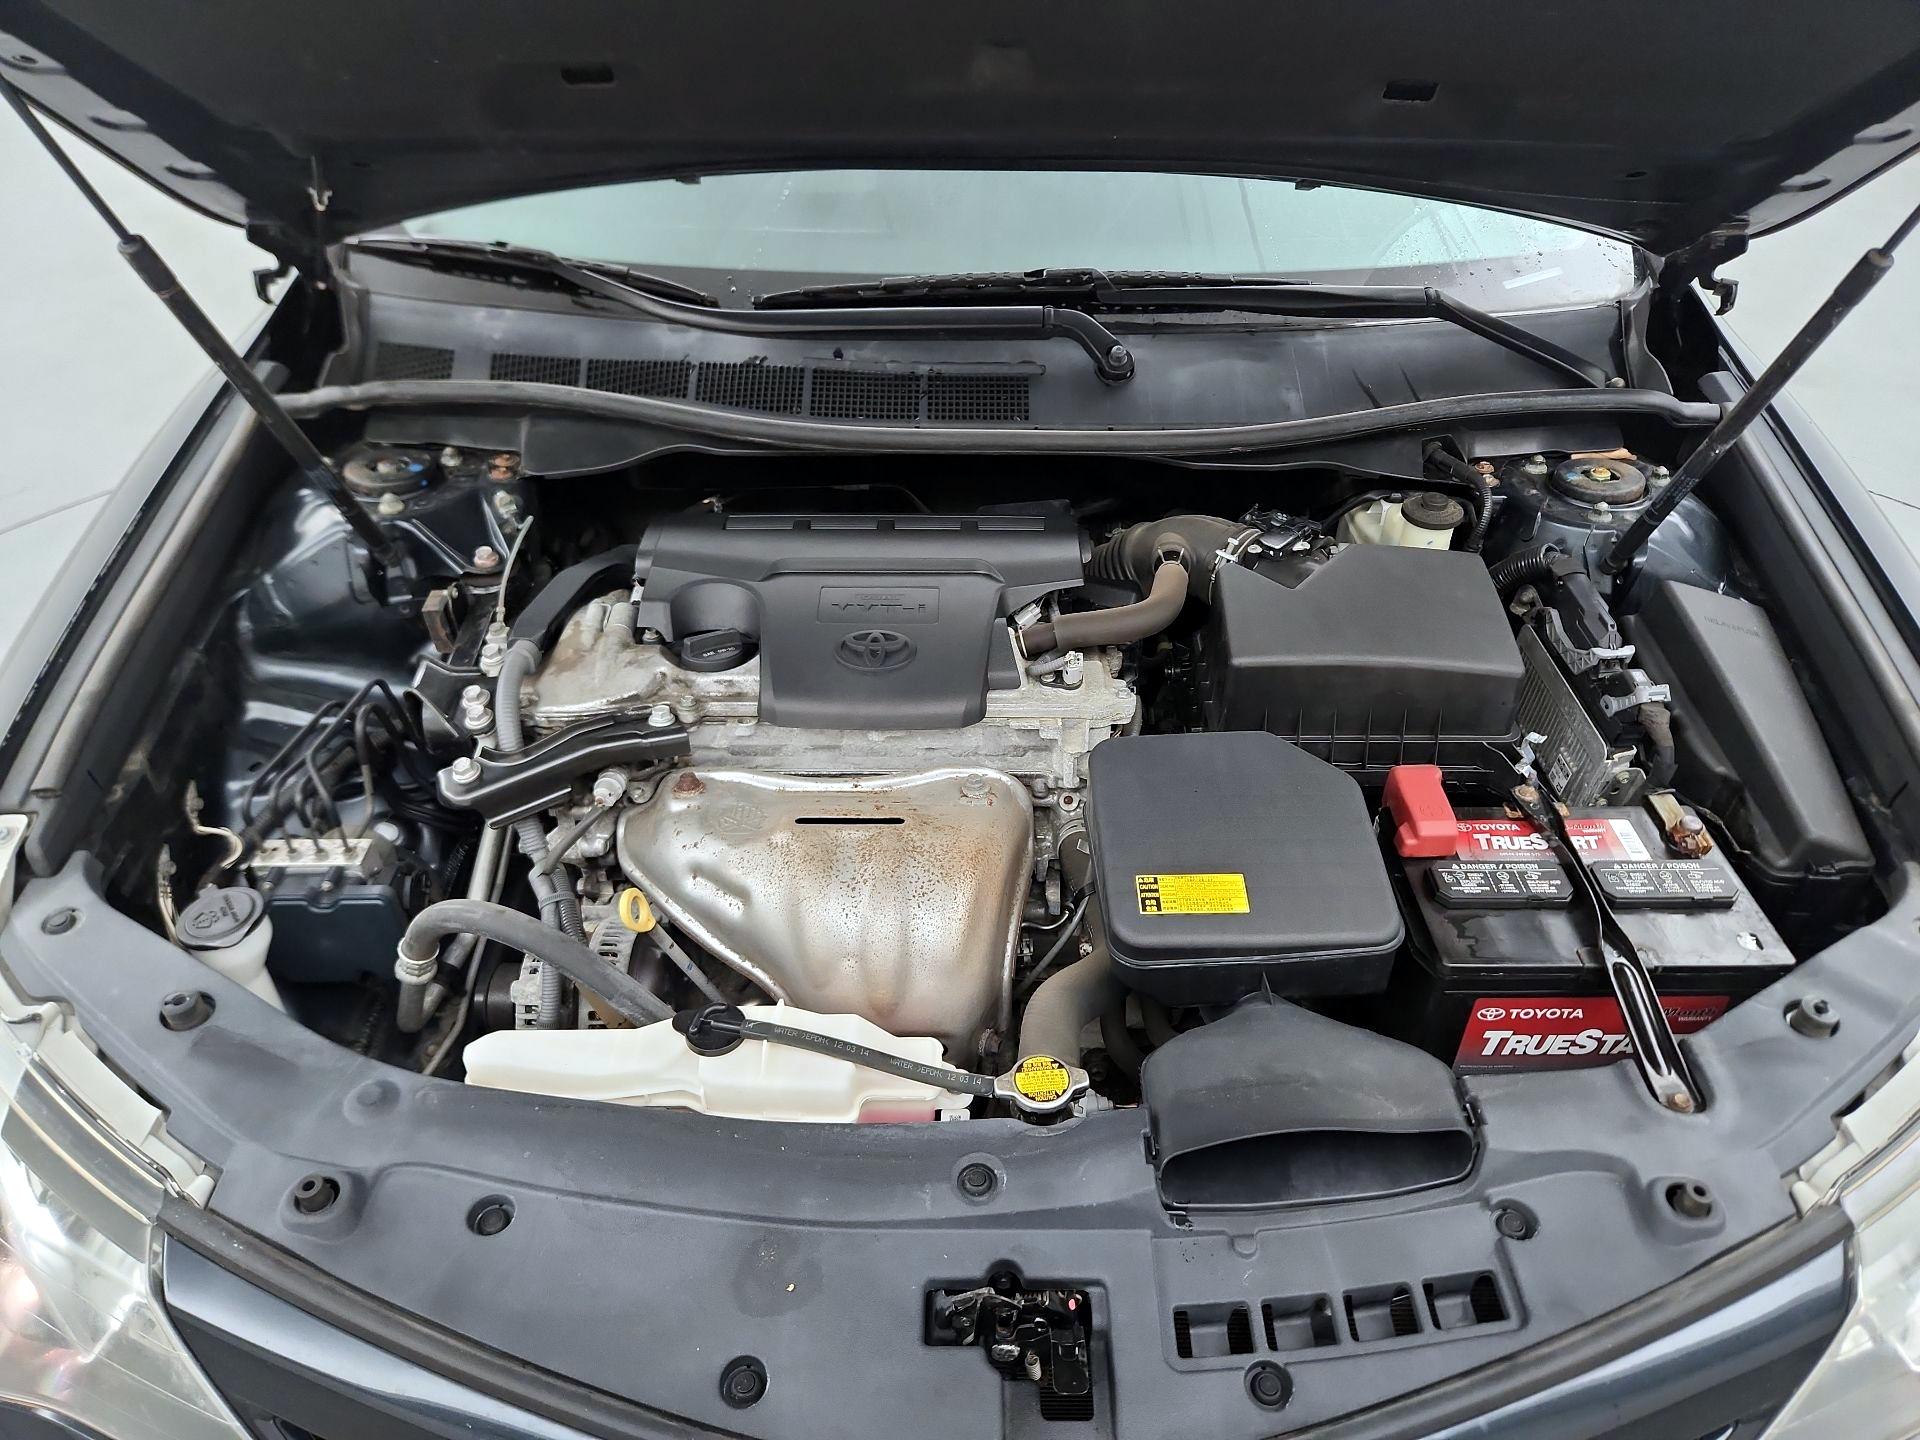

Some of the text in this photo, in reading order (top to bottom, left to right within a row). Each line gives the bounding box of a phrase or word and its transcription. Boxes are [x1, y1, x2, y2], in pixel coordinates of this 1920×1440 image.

[1473, 823, 1520, 831] TOYOTA
[1473, 832, 1599, 850] TRUESRT
[1510, 1008, 1584, 1019] TOYOTA
[774, 1026, 798, 1036] WATER
[833, 1041, 843, 1049] 12
[846, 1045, 856, 1053] 03
[860, 1048, 870, 1056] 14
[1482, 1029, 1635, 1056] TRUESTA
[890, 1058, 913, 1070] WATER
[947, 1073, 956, 1081] 12
